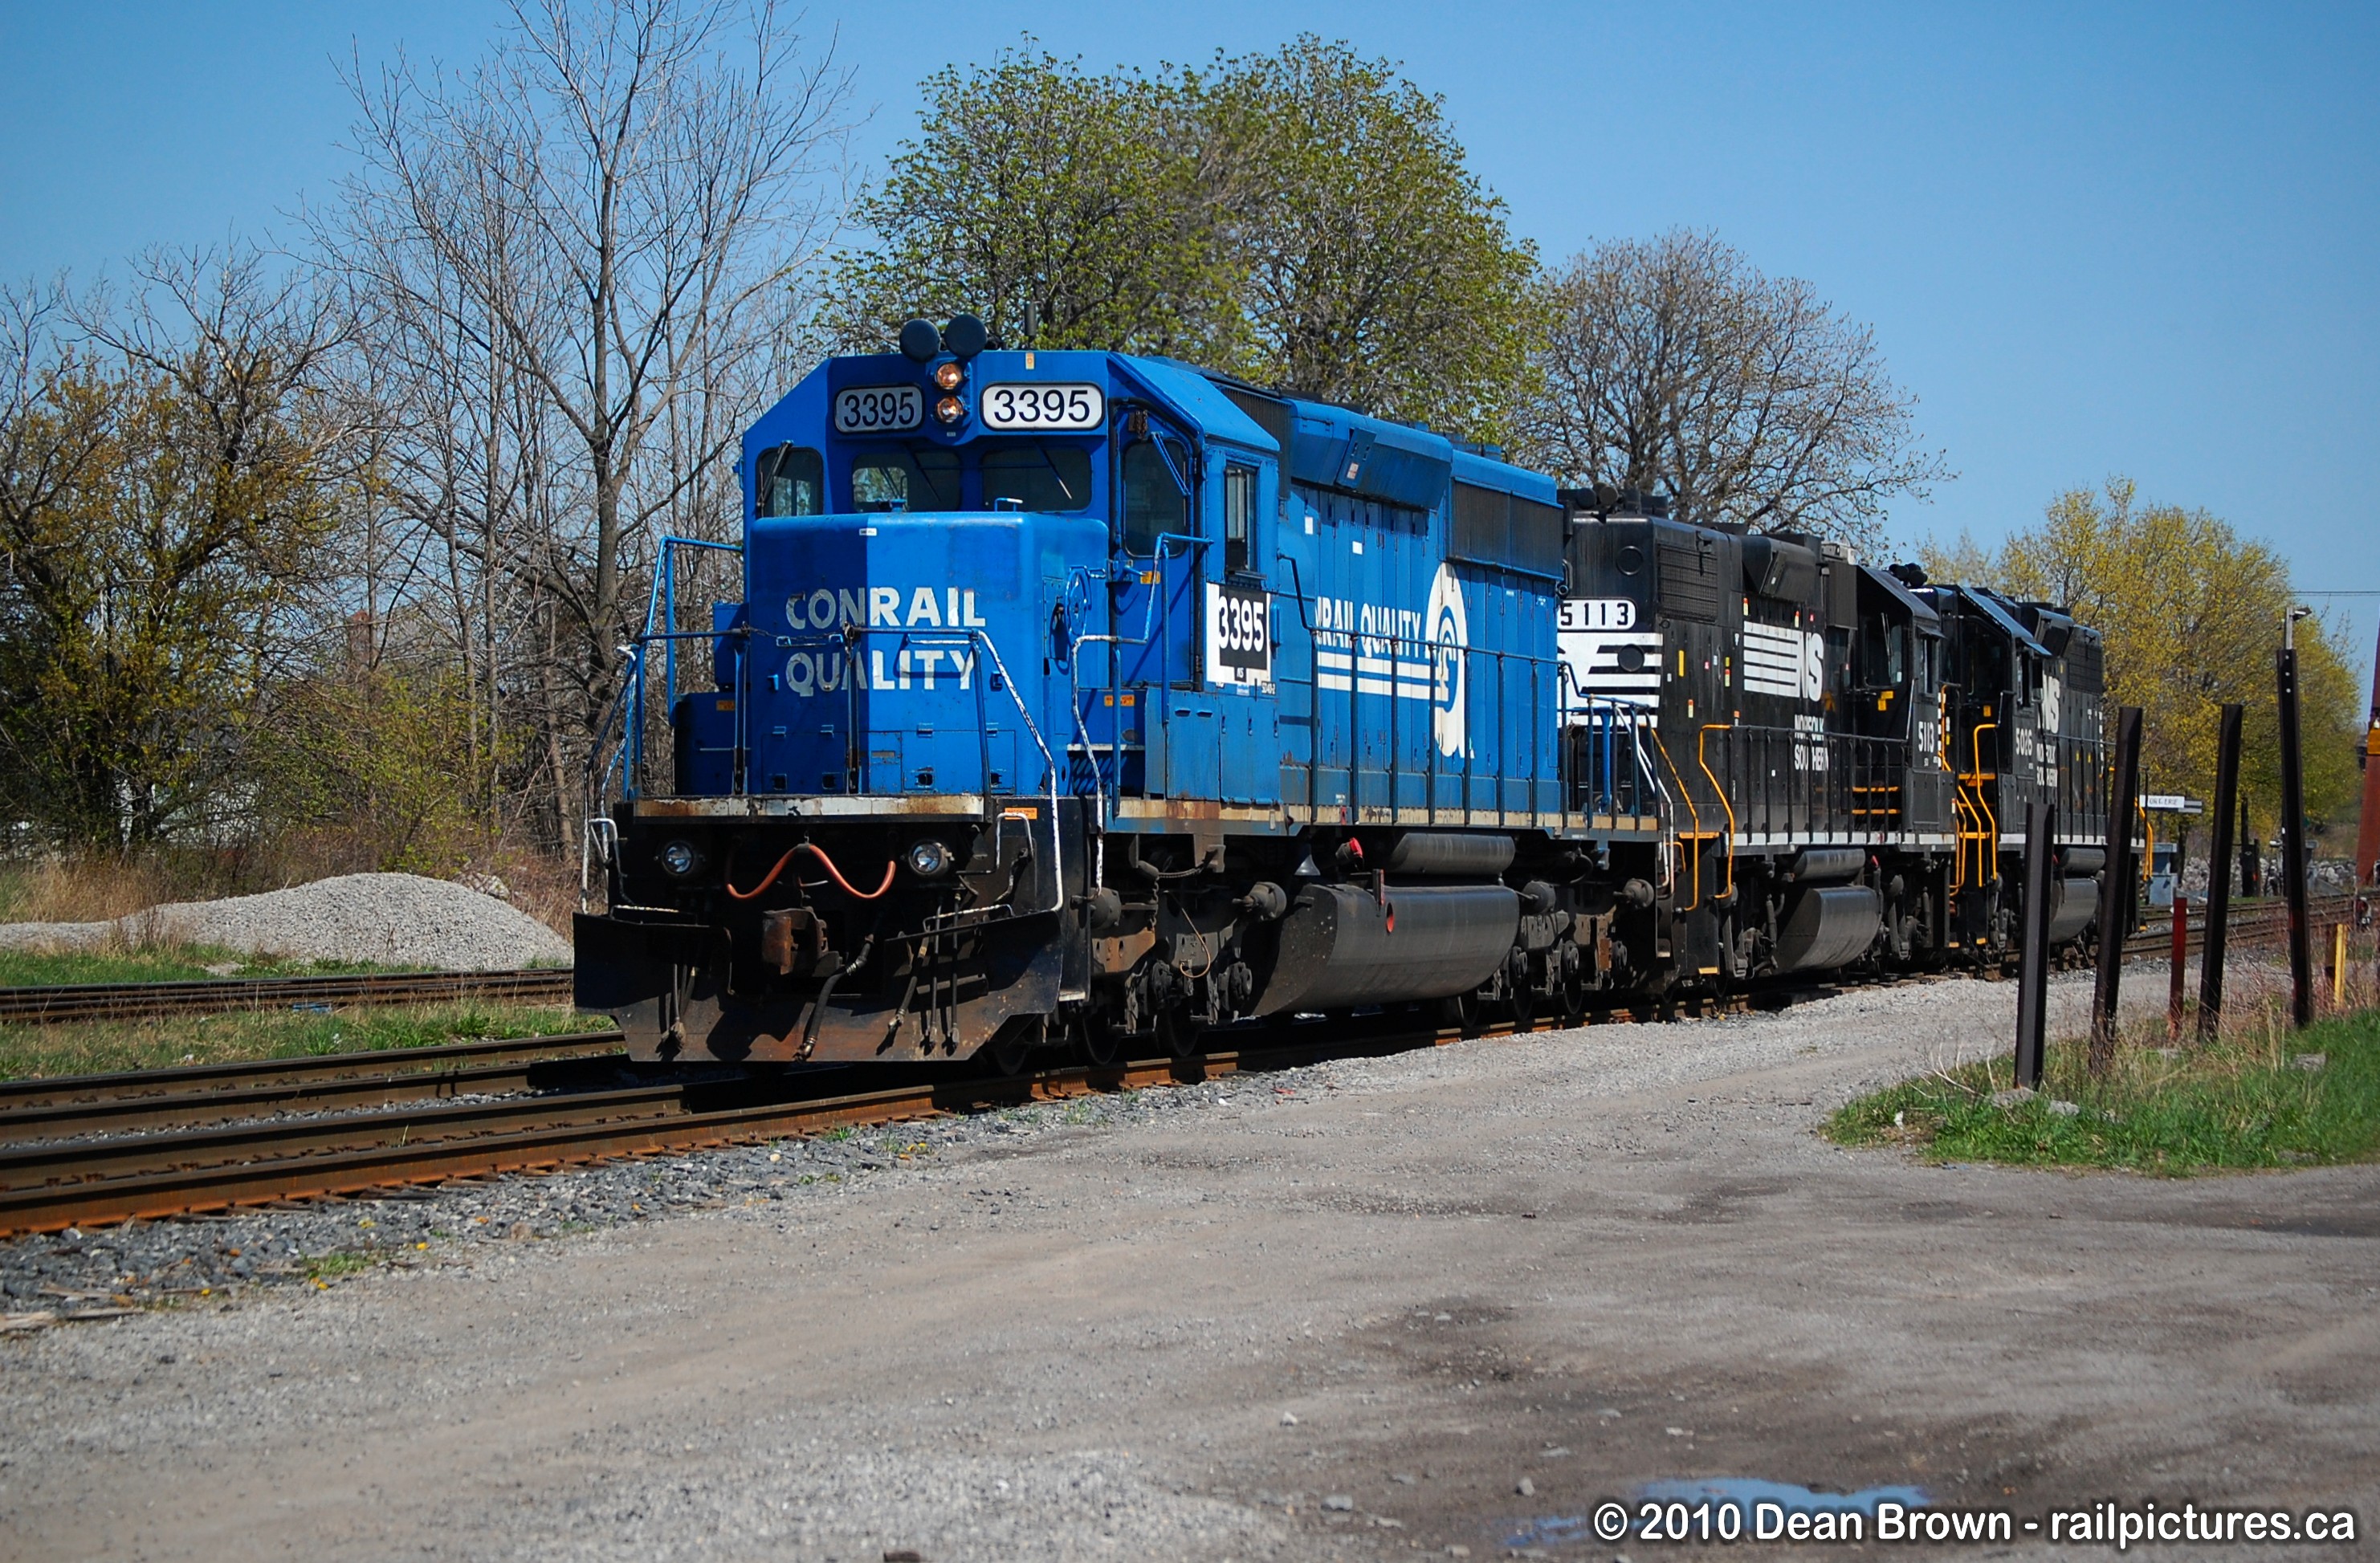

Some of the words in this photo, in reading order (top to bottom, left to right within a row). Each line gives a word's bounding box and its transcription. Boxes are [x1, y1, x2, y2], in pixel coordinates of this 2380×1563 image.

[843, 391, 915, 428] 3395
[993, 389, 1090, 423] 3395
[785, 587, 986, 630] CONRAIL
[1218, 595, 1265, 653] 3395
[1560, 602, 1629, 626] 5113
[1359, 603, 1421, 659] QUALITY
[785, 649, 976, 698] QUALITY
[1917, 721, 1934, 753] 5113
[2015, 727, 2033, 756] 5026
